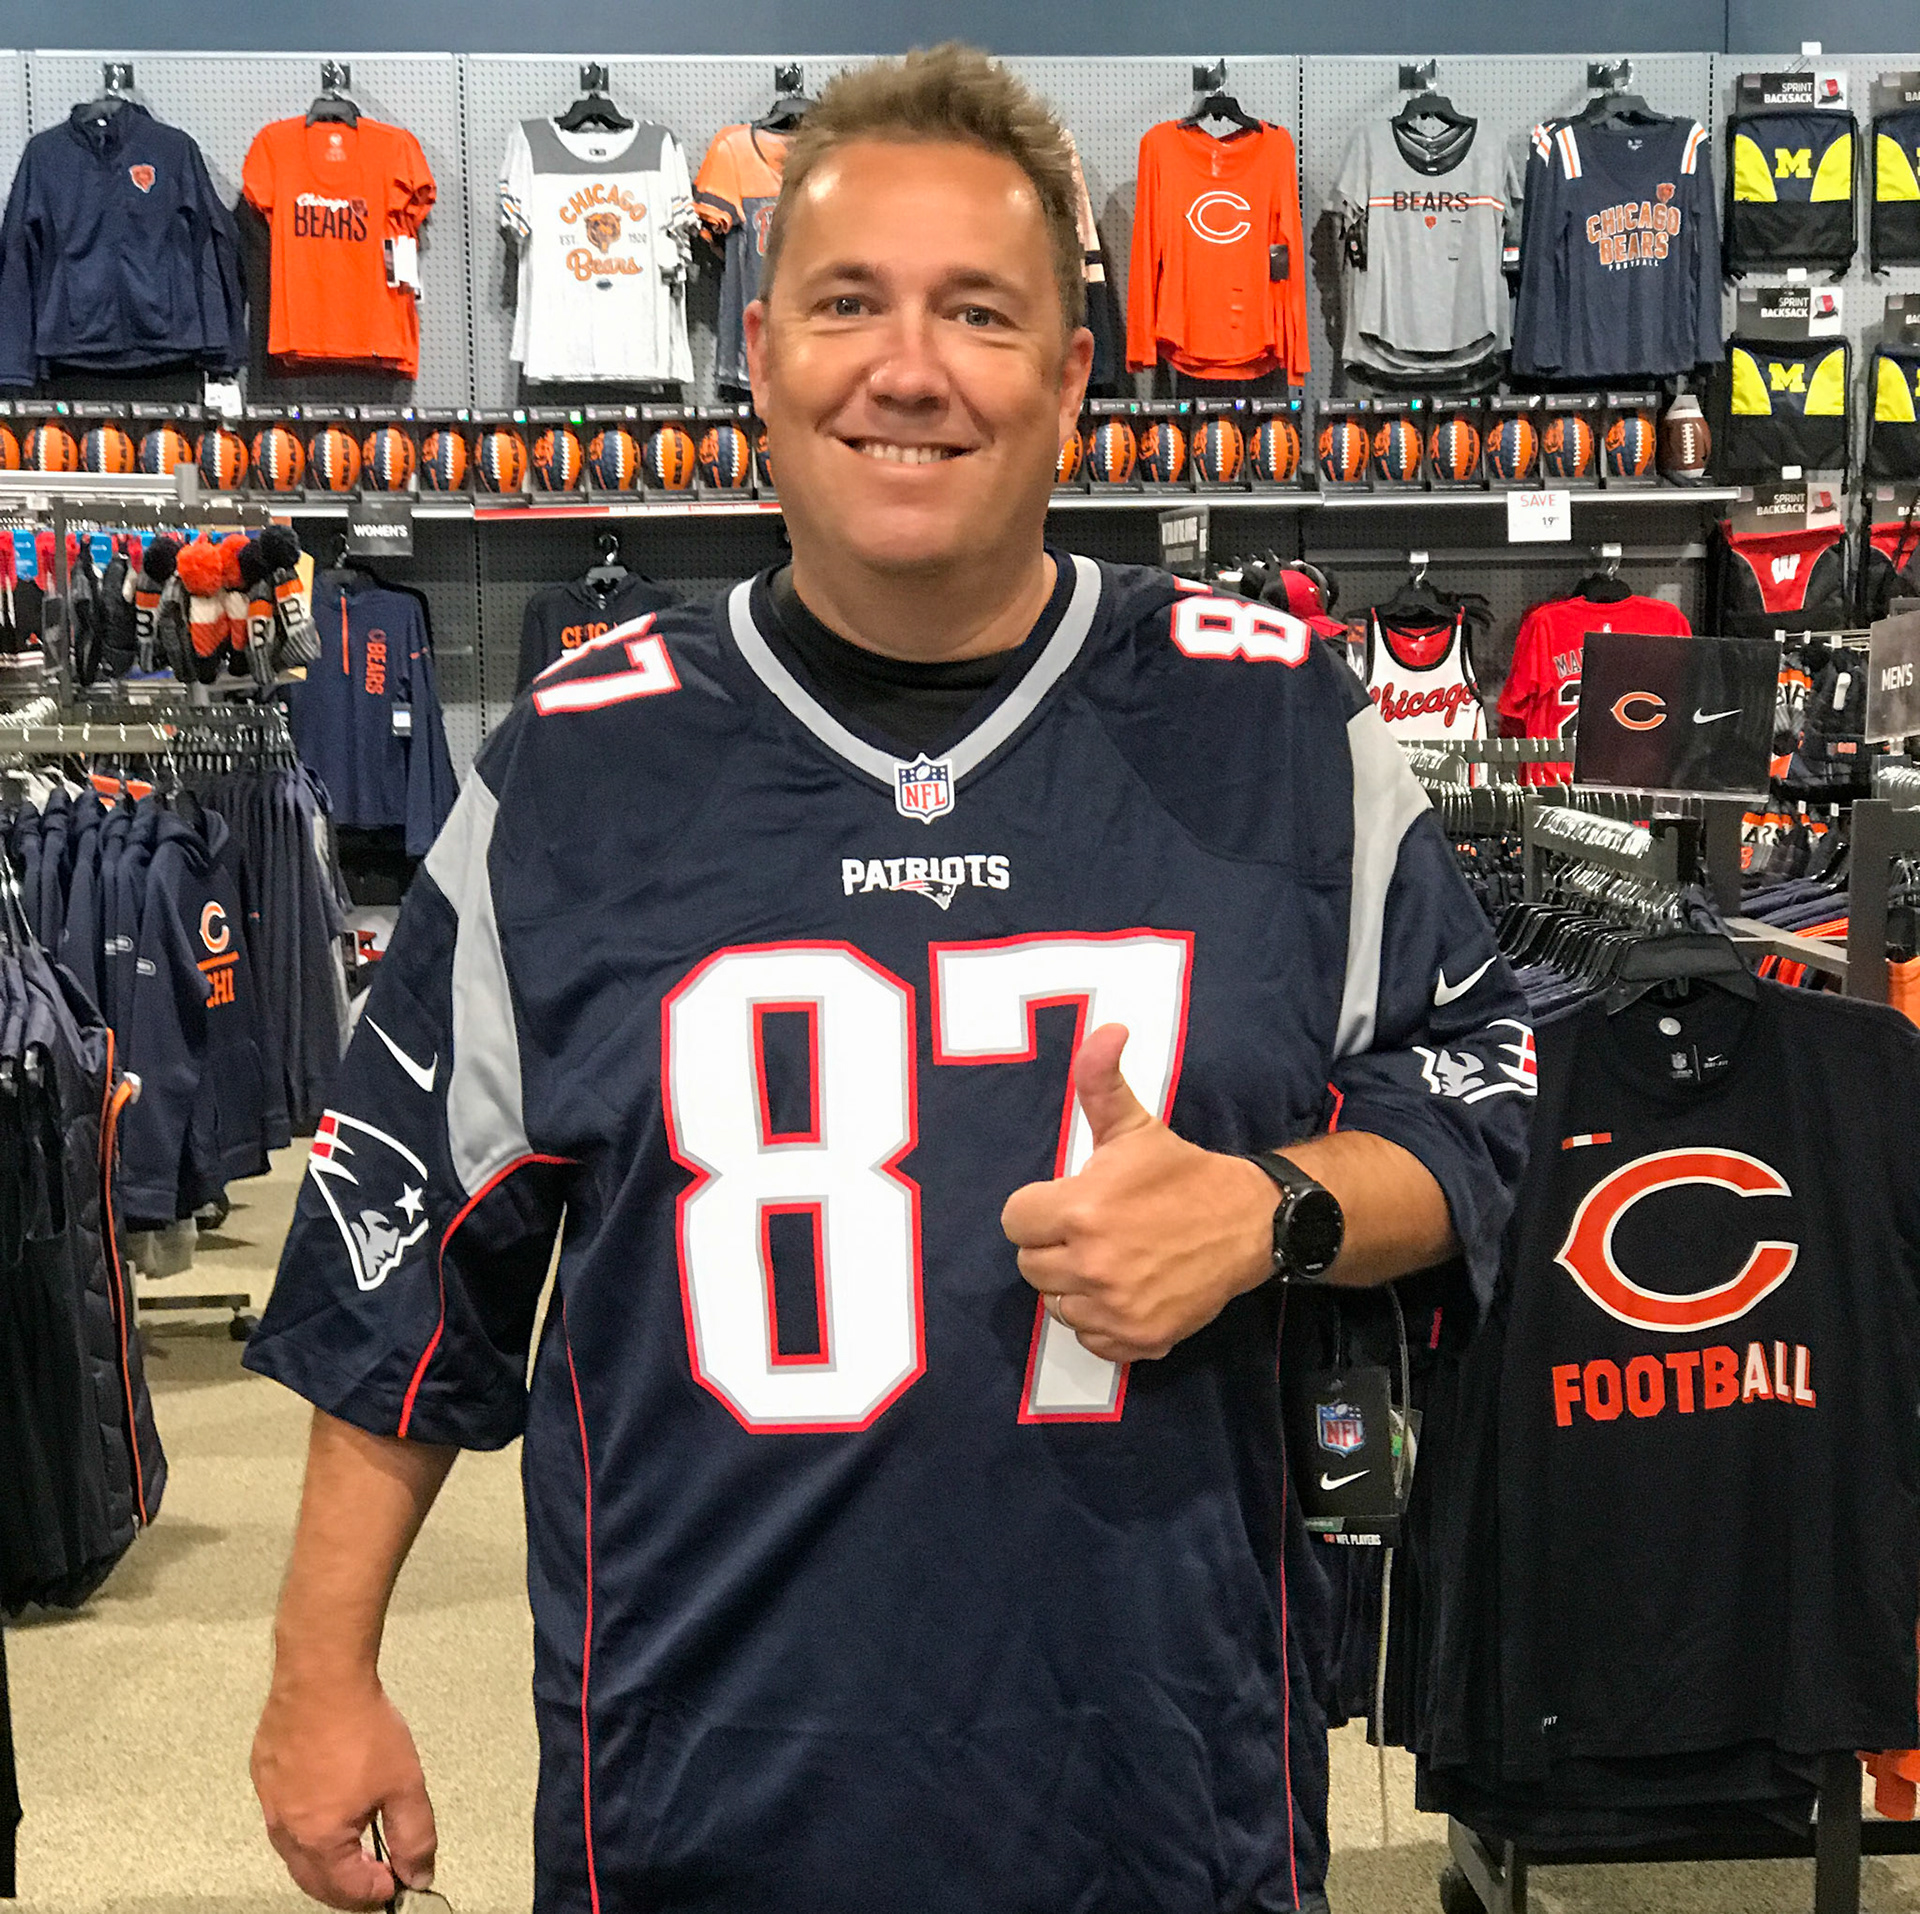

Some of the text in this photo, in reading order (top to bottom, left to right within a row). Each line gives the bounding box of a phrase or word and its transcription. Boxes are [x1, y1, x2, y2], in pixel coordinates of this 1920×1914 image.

[1763, 93, 1813, 104] BACKSACK
[1782, 82, 1813, 92] SPRINT
[1774, 148, 1813, 179] M
[559, 183, 648, 222] CHICAGO
[1393, 190, 1470, 213] BEARS
[294, 200, 368, 242] BEARS
[1586, 201, 1682, 244] CHICAGO
[1599, 231, 1669, 266] BEARS
[566, 248, 644, 282] Bears
[1608, 259, 1659, 271] FOOTBALL
[1760, 307, 1809, 318] BACKSACK
[1778, 296, 1809, 307] SPRINT
[1768, 363, 1807, 393] M
[1520, 493, 1557, 507] SAVE
[1756, 504, 1806, 516] BACKSACK
[1774, 493, 1806, 504] SPRINT
[352, 524, 409, 538] WOMEN'S
[1770, 553, 1801, 585] W
[1553, 647, 1584, 679] MA
[1881, 662, 1914, 692] MEN'S
[904, 782, 947, 810] NFL
[841, 855, 1011, 897] PATRIOTS
[661, 926, 1196, 1435] 87
[1553, 1147, 1799, 1333] C
[1552, 1339, 1817, 1428] FOOTBALL
[1325, 1420, 1363, 1448] NFL
